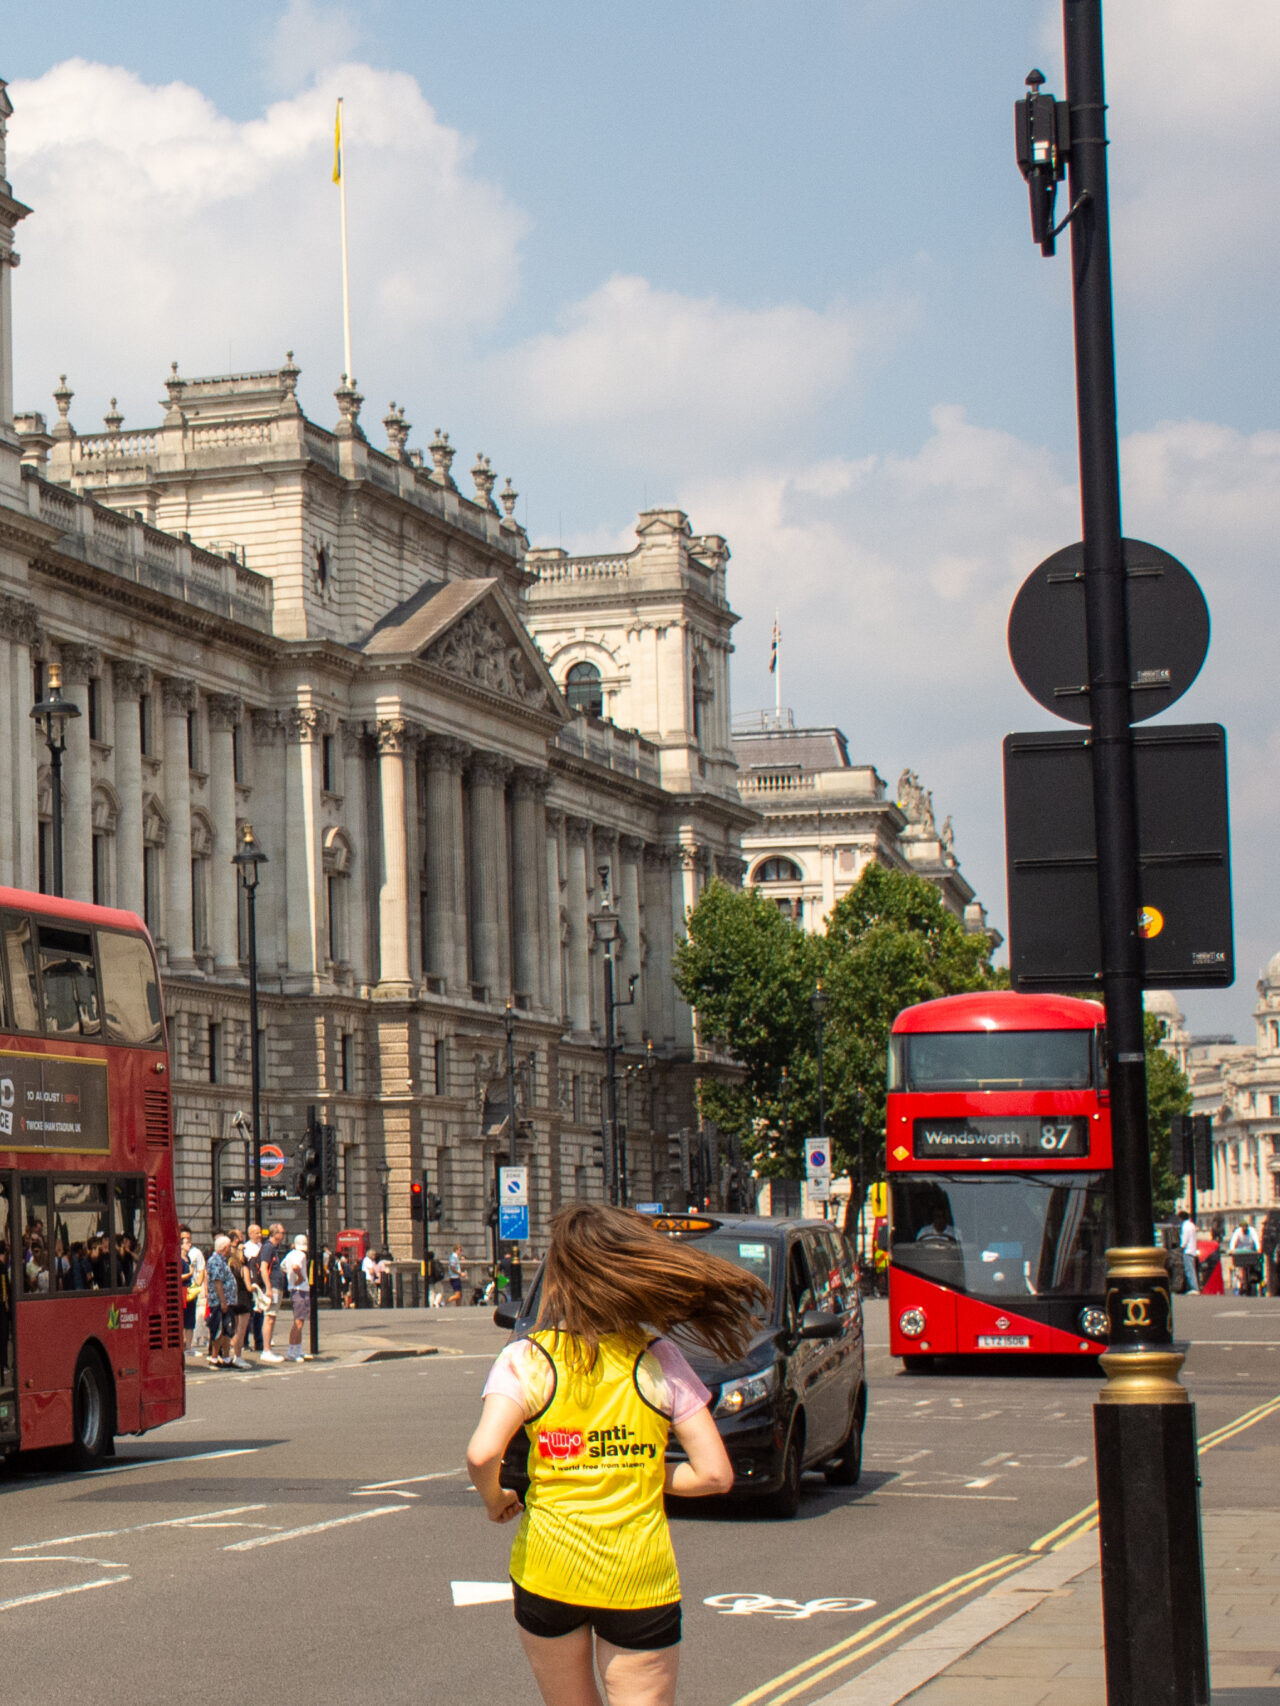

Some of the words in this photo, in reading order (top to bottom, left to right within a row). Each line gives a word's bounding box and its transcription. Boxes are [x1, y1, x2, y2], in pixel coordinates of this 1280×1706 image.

[35, 1092, 60, 1103] AUGUST
[924, 1131, 1021, 1144] Wandsworth
[1041, 1125, 1072, 1149] 87
[657, 1219, 690, 1231] AXI
[587, 1425, 635, 1442] anti-
[589, 1442, 656, 1459] slavery
[558, 1464, 580, 1472] world
